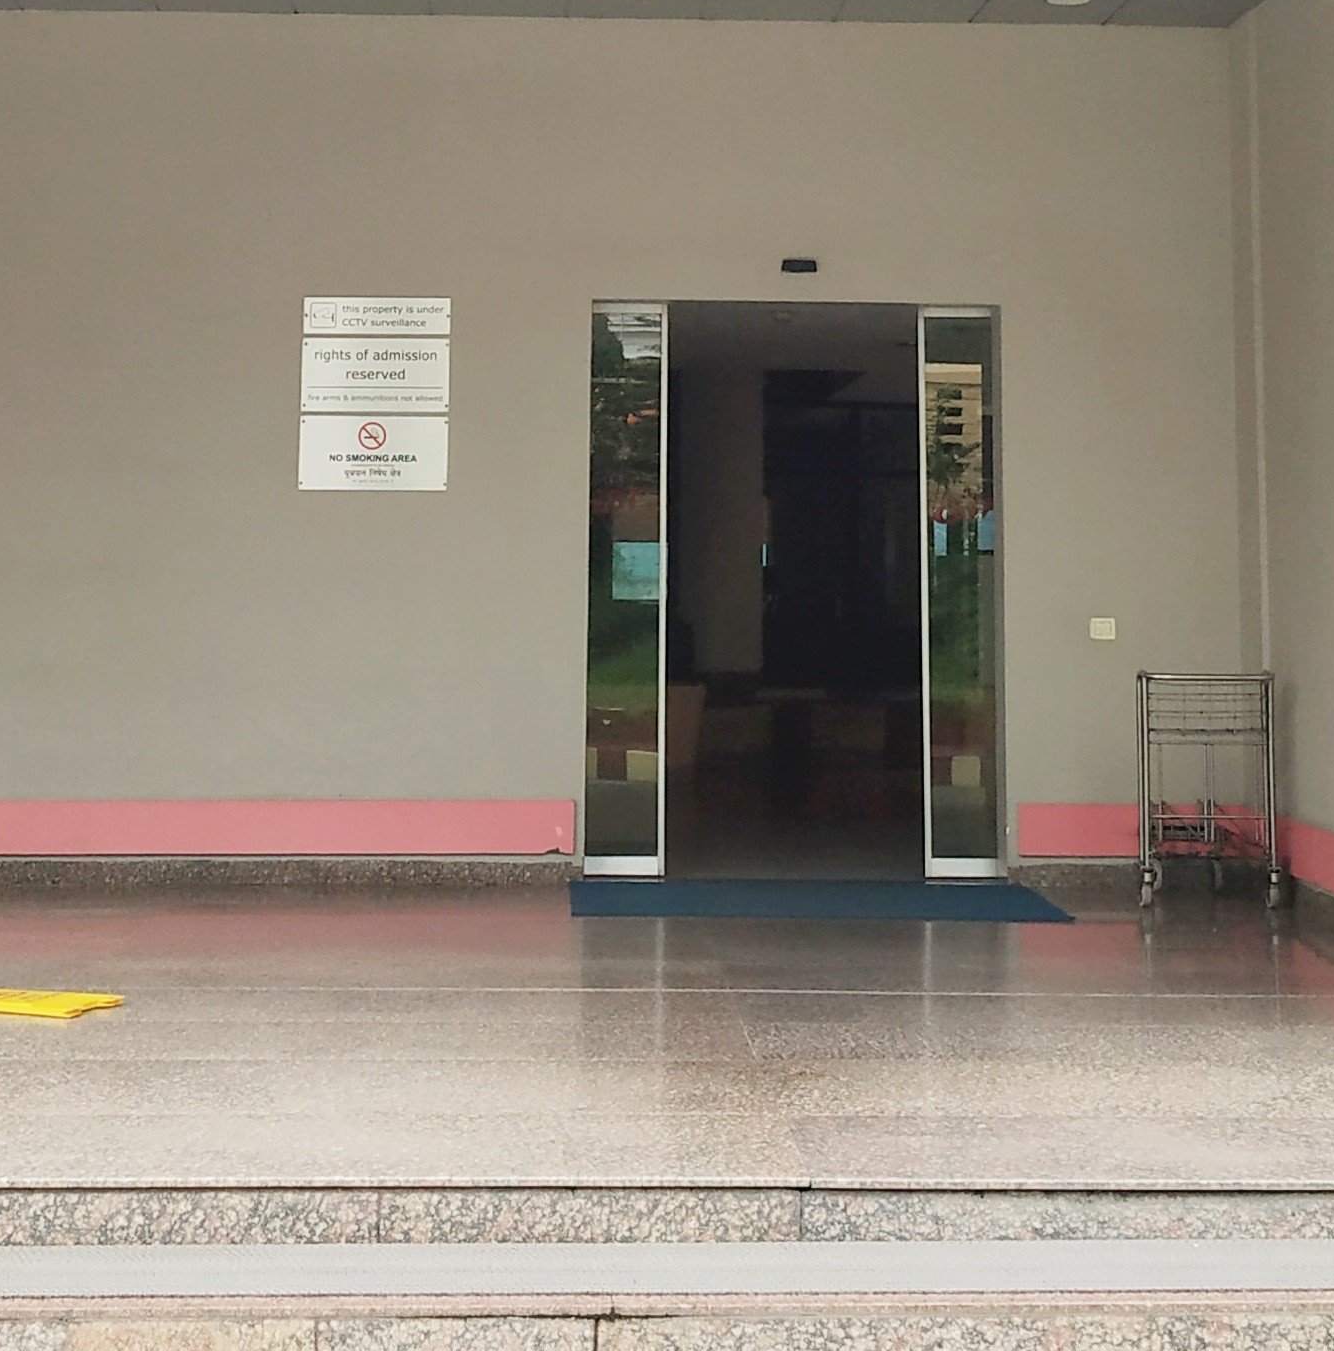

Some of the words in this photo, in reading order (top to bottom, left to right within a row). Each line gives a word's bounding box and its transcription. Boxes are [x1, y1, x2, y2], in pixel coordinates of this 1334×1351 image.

[342, 305, 360, 314] this
[363, 305, 403, 315] property
[406, 305, 414, 314] is
[416, 305, 444, 314] under
[342, 318, 367, 327] CCTV
[370, 318, 427, 327] surveillance
[314, 349, 351, 363] rights
[356, 349, 369, 361] of
[372, 349, 438, 361] admission
[345, 369, 406, 380] reserved
[329, 454, 343, 462] NO
[346, 454, 389, 462] SMOKING
